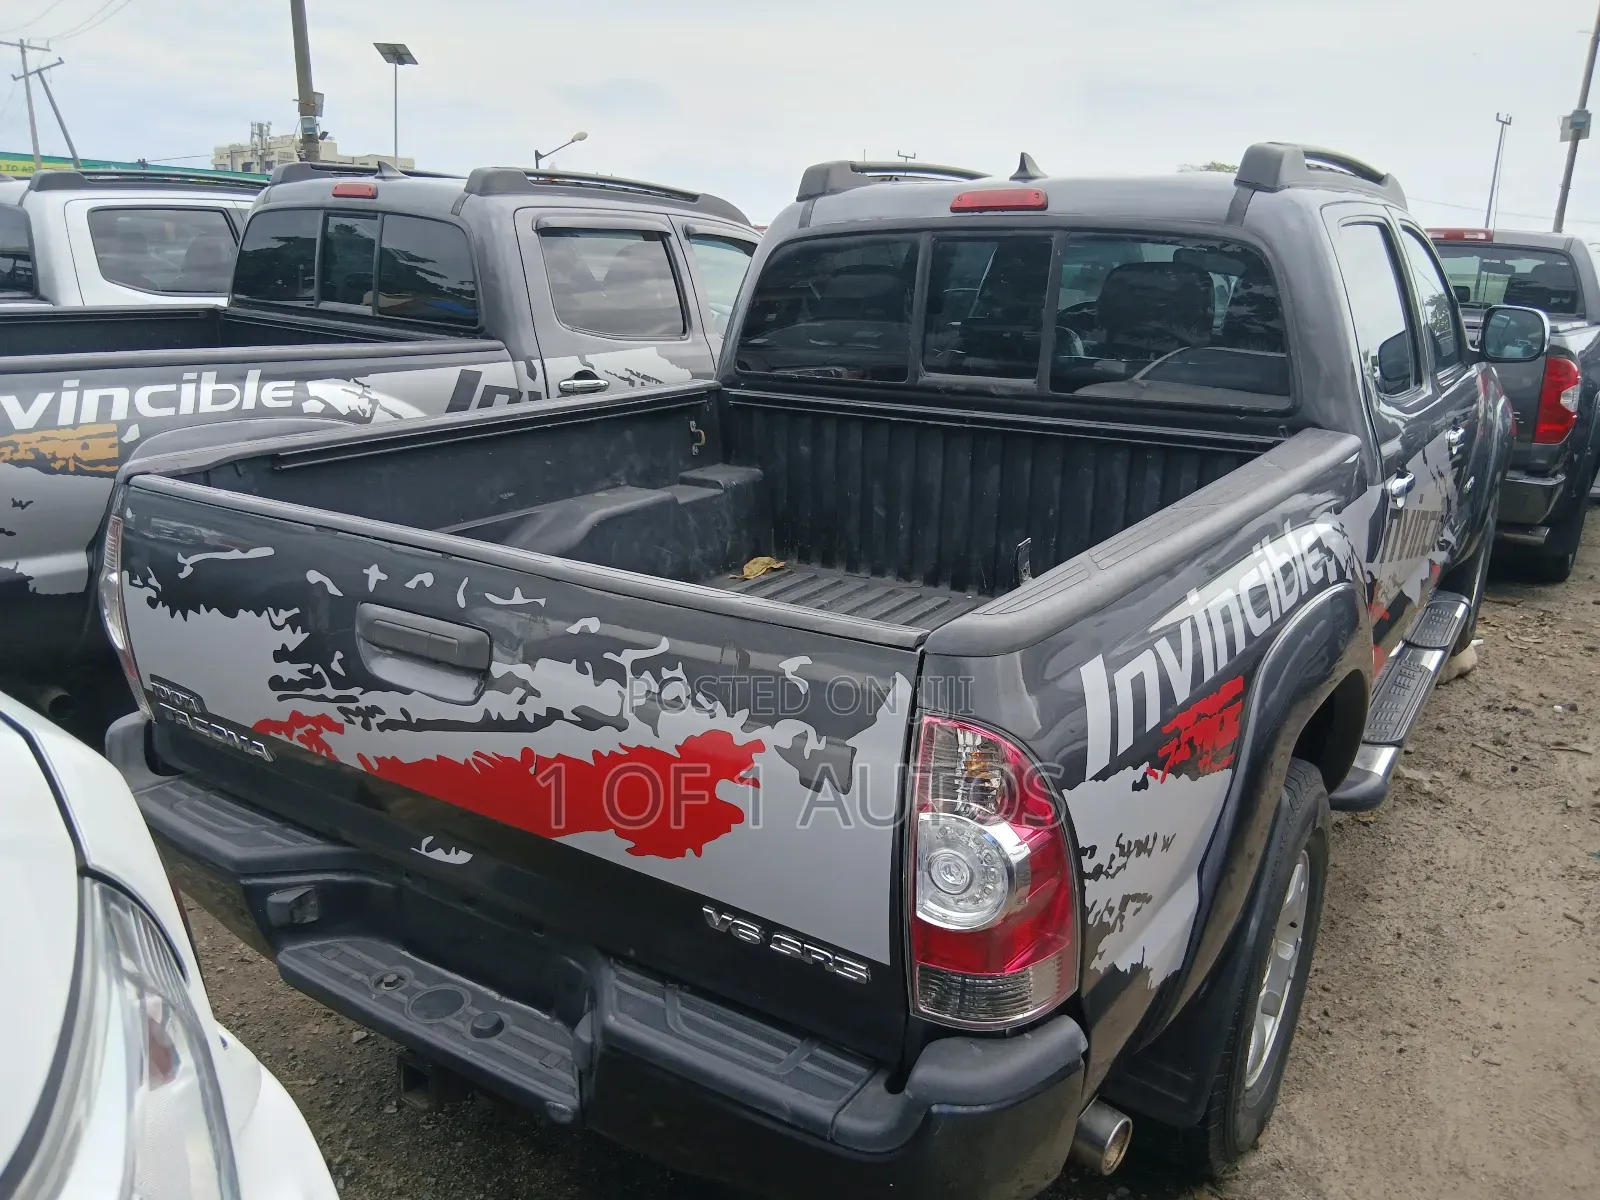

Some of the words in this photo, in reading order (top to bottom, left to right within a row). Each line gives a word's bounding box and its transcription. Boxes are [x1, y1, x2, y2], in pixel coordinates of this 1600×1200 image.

[1080, 518, 1324, 781] Invincible
[150, 681, 202, 713] TOYOTA
[159, 702, 275, 762] TACOMA
[702, 905, 766, 945] V6
[769, 931, 872, 985] SR5
